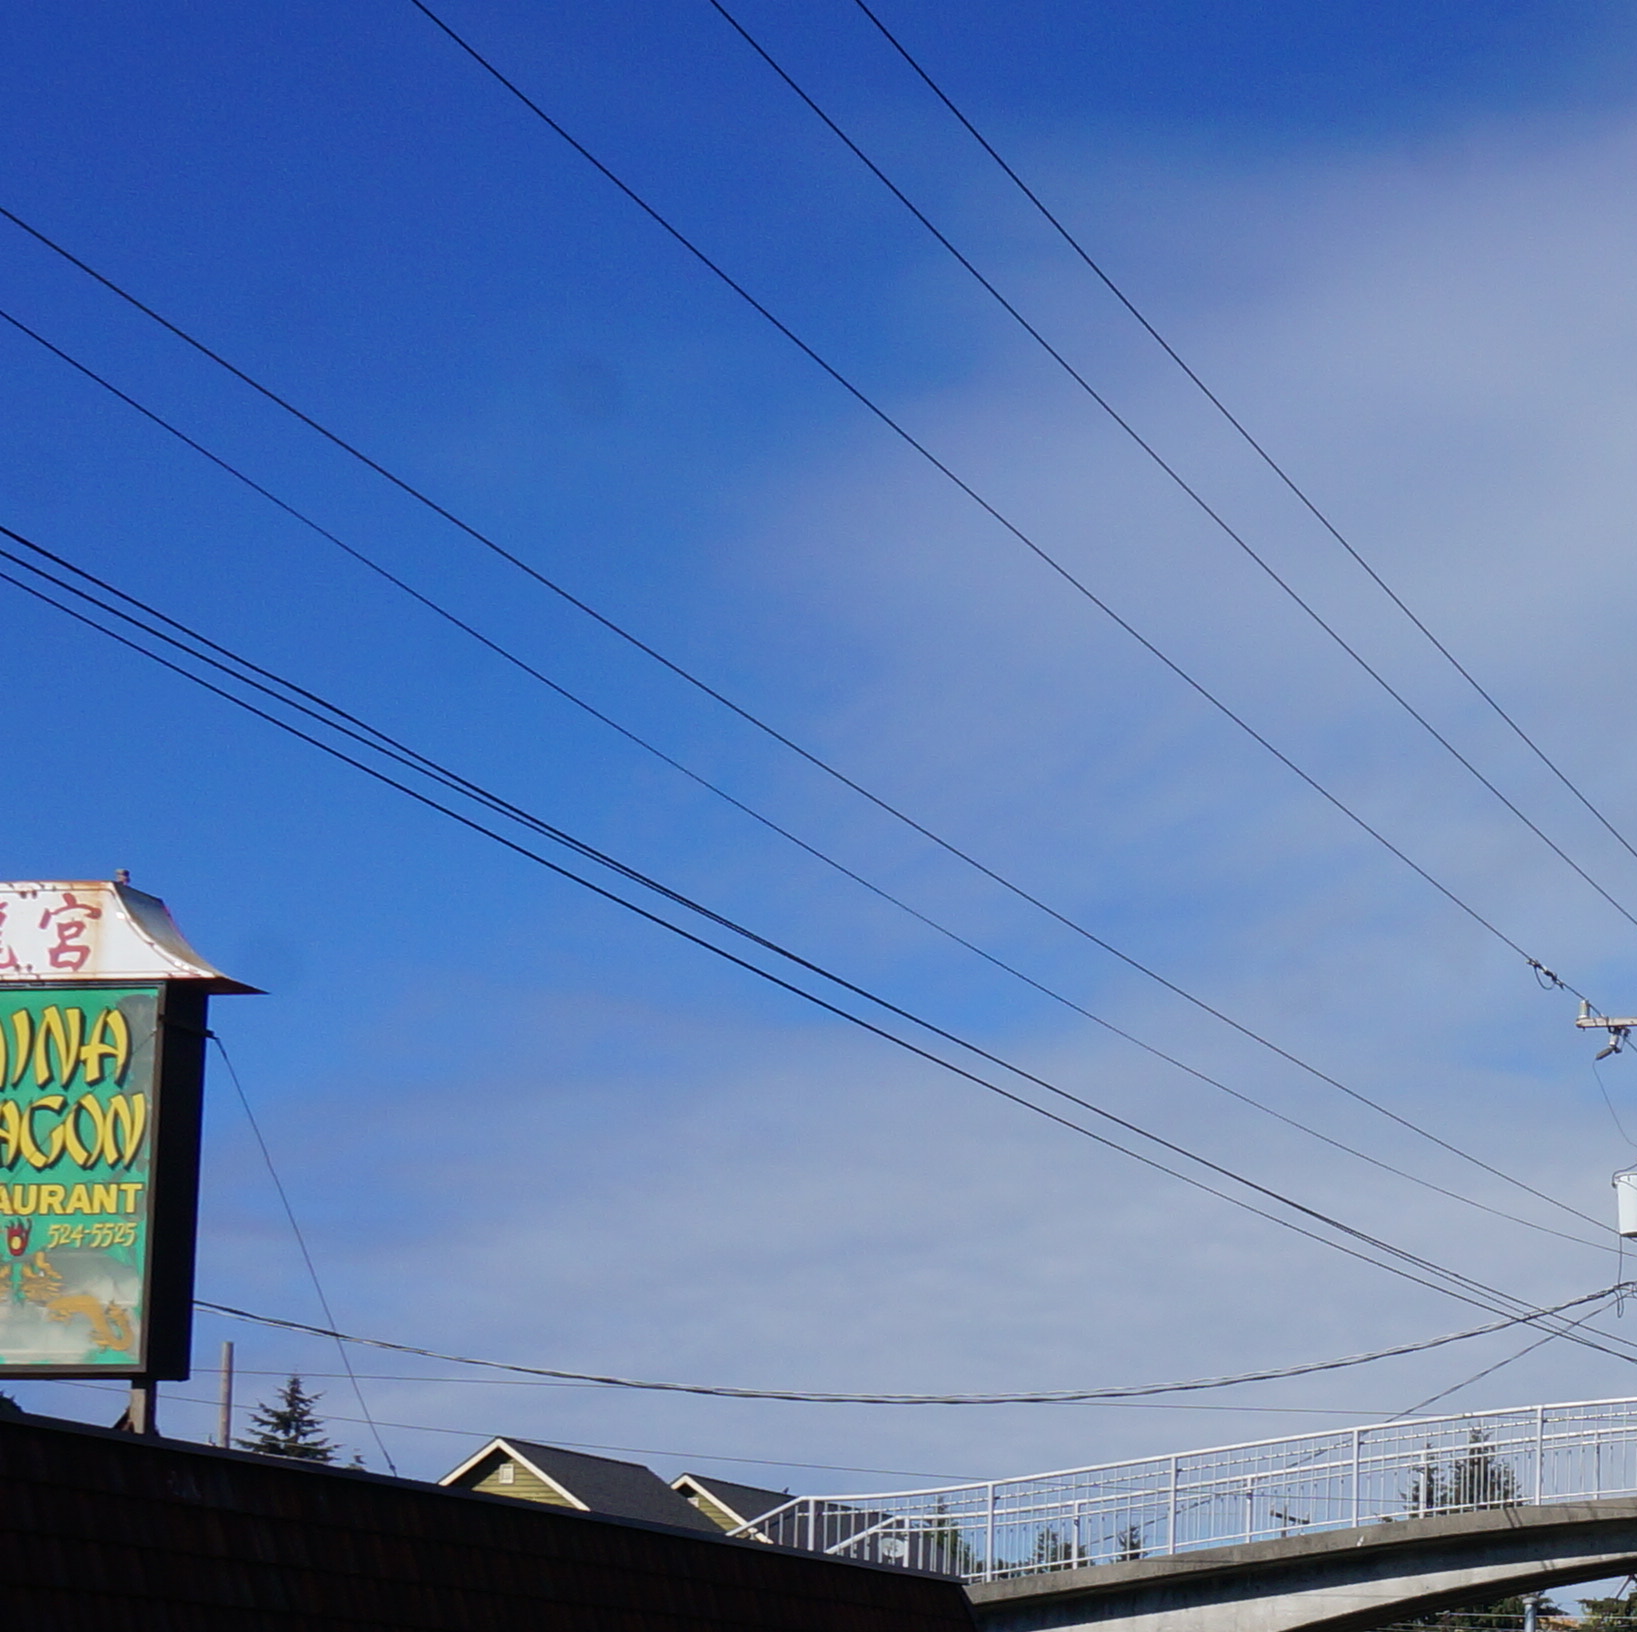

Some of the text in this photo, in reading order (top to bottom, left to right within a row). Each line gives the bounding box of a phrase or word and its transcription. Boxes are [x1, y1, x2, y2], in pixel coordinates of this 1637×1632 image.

[0, 893, 102, 972] 宮
[0, 1004, 132, 1091] INA
[47, 1222, 137, 1248] 524-5525
